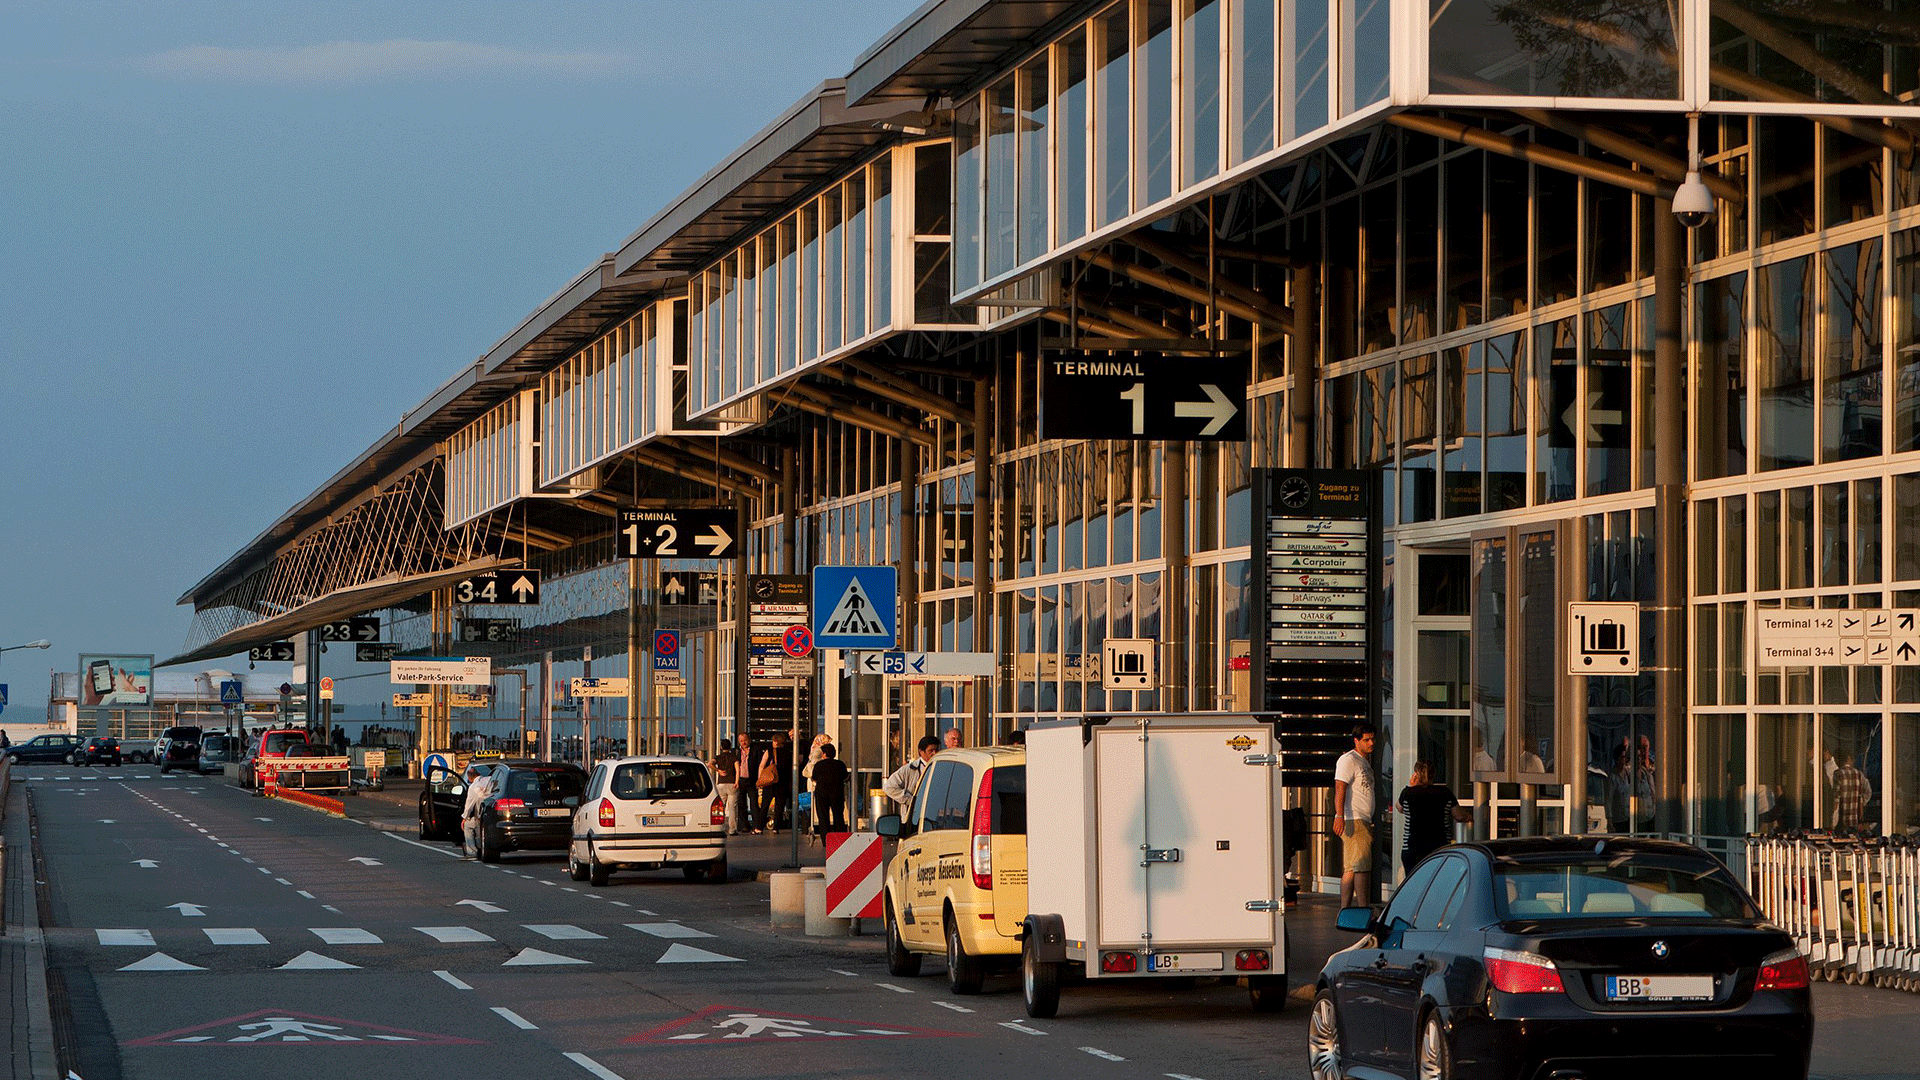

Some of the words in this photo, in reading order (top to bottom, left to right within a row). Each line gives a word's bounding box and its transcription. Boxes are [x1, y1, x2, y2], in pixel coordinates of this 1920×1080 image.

[1053, 361, 1145, 377] TERMINAL
[1119, 382, 1145, 435] 1
[1318, 483, 1348, 492] Zugang
[1318, 493, 1352, 501] Terminal
[622, 511, 678, 522] TERMINAL
[1302, 557, 1347, 568] Carpatair
[1300, 612, 1325, 620] QATAR
[1764, 618, 1811, 629] Terminal
[1814, 618, 1834, 628] 1+2
[1765, 646, 1812, 657] Terminal
[1814, 646, 1834, 657] 3+4
[655, 657, 678, 667] TAXI
[885, 657, 904, 672] P5
[938, 859, 966, 880] Reisebüro
[1155, 955, 1172, 968] LB
[1618, 978, 1641, 995] BB
